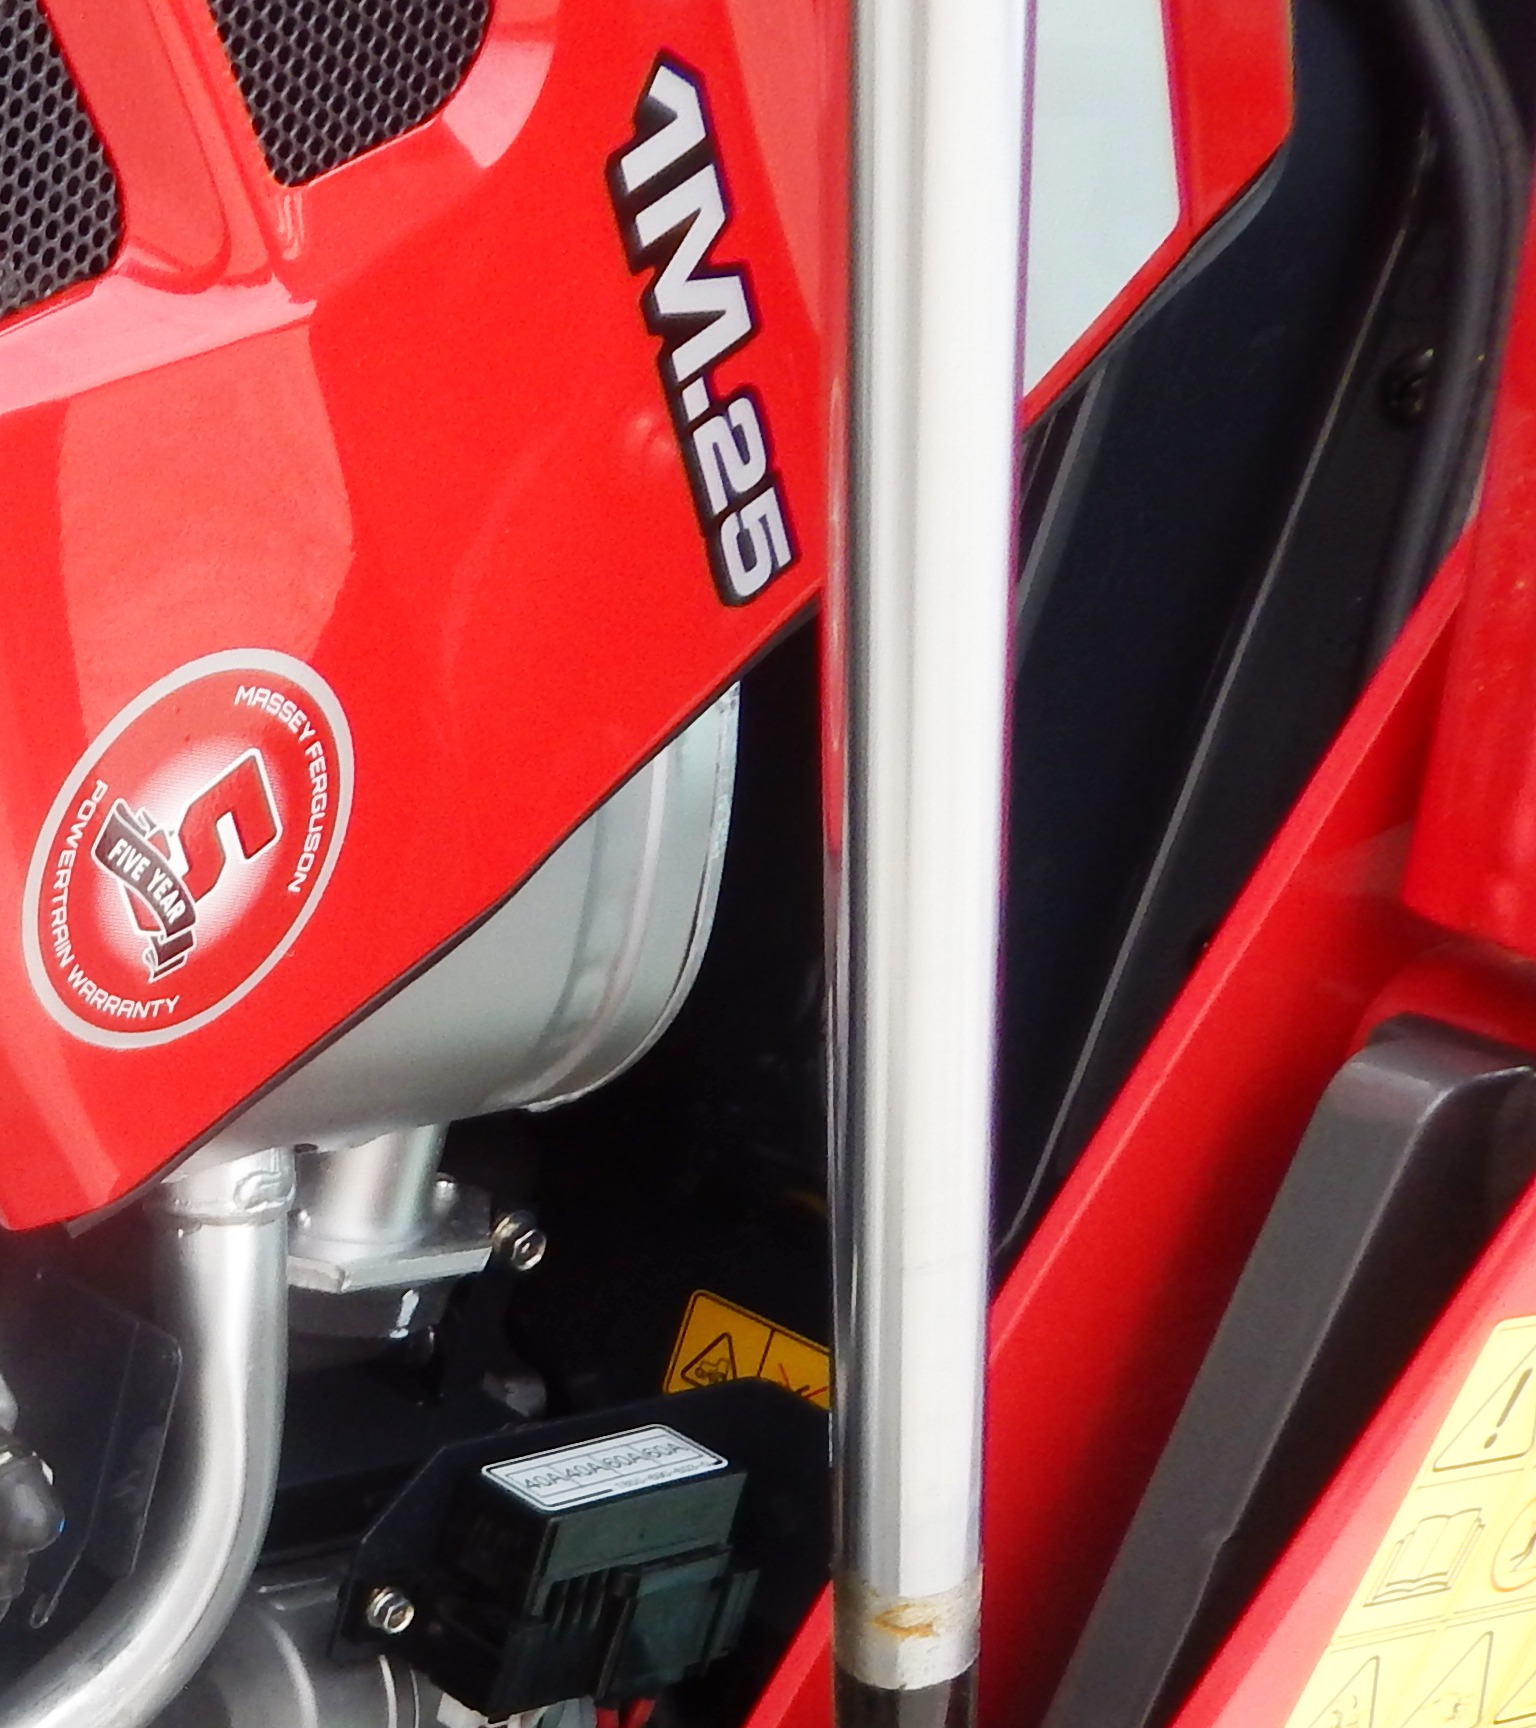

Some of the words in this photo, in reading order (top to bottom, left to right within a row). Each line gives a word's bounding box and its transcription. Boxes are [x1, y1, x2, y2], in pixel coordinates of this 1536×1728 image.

[614, 57, 796, 602] 1M.25
[50, 778, 109, 969] POWERTRAIN
[107, 837, 148, 882] FIVE
[143, 858, 188, 924] YEAR
[233, 684, 316, 742] MASSEY
[287, 740, 328, 893] FERGUSON
[66, 963, 180, 1019] WARRANTY
